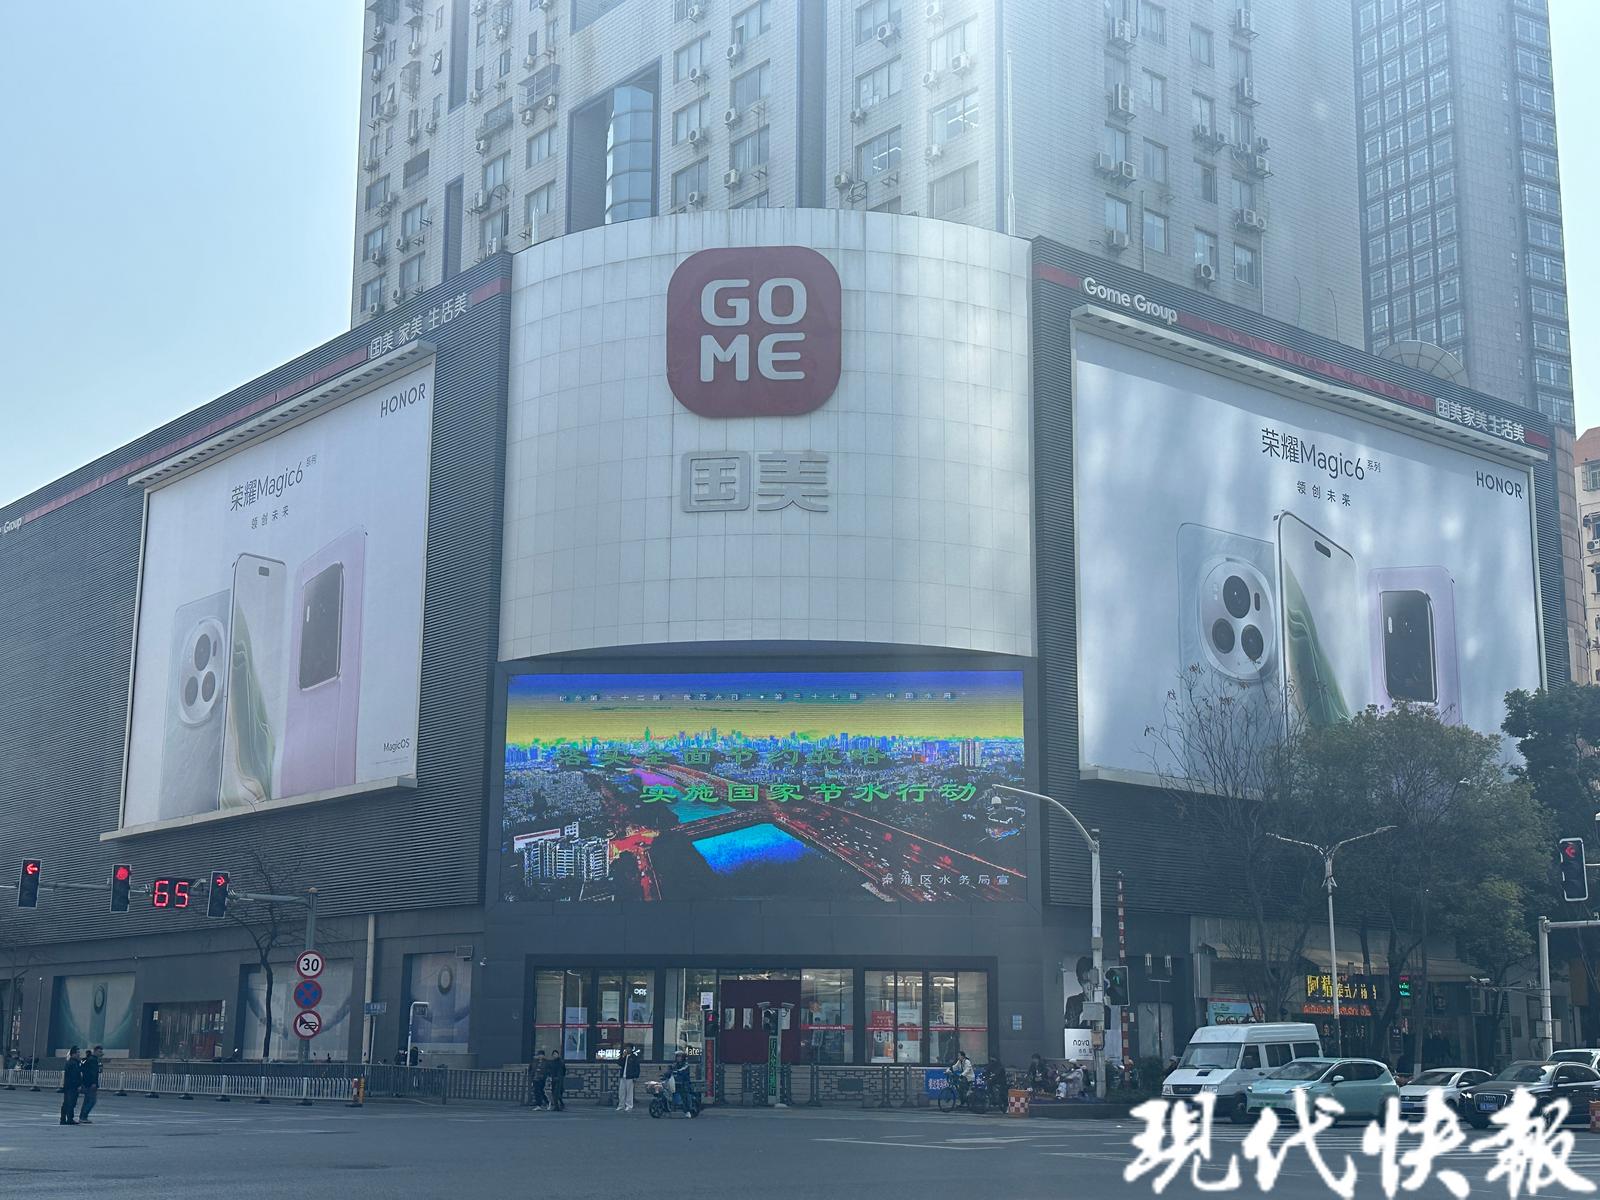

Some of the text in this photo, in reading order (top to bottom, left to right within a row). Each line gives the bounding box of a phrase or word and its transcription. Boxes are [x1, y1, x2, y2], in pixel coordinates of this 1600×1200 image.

[1084, 277, 1178, 325] Gome Group
[380, 382, 426, 419] HONOR
[1261, 427, 1365, 480] 荣耀Magic6
[230, 461, 304, 512] 荣耀Magic6
[680, 450, 830, 513] 国美
[1297, 480, 1351, 507] 领创未来
[1476, 470, 1523, 500] HONOR
[383, 738, 410, 752] MagicOS
[639, 782, 977, 803] 实施国家节水行动
[153, 880, 190, 908] 65
[881, 873, 1010, 887] 秦淮区水务局宣
[302, 958, 320, 972] 30
